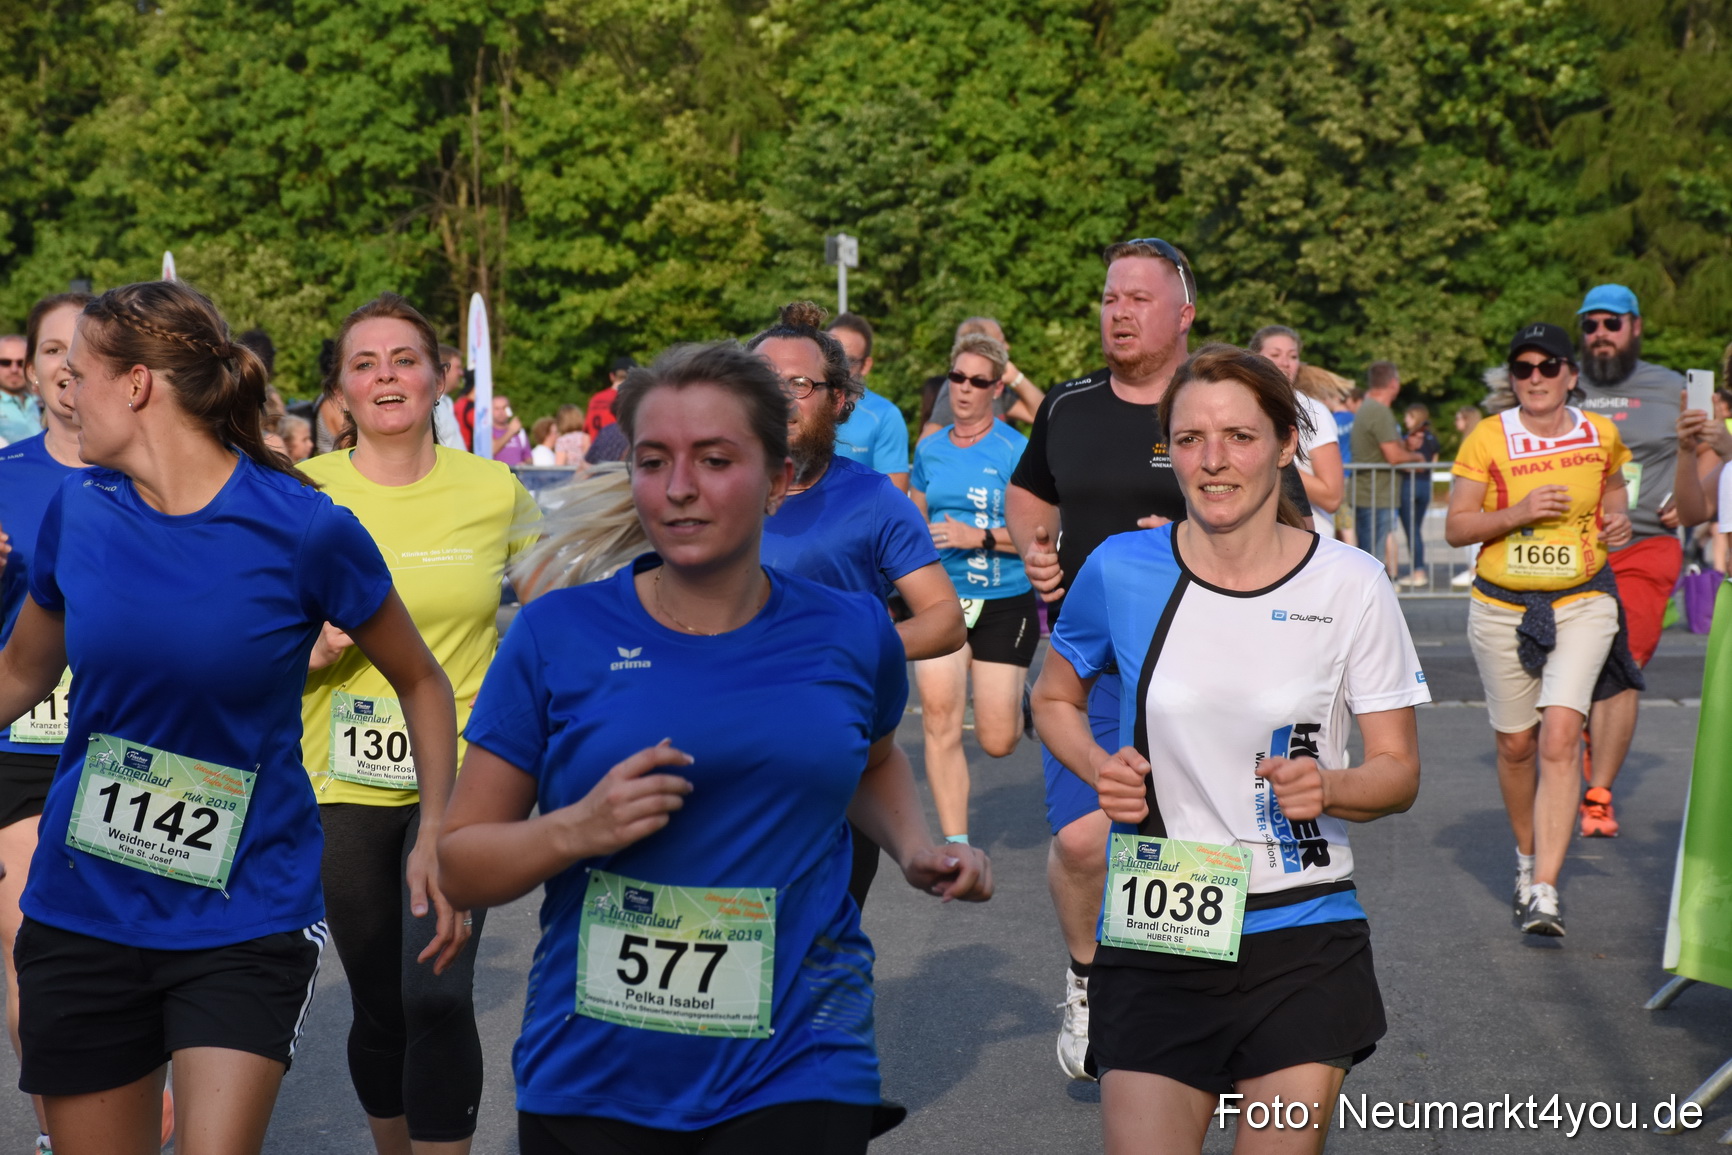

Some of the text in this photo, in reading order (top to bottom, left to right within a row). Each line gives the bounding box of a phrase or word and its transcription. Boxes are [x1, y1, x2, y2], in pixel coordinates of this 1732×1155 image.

[1511, 452, 1605, 477] MAX BÖGL
[94, 482, 117, 492] JAKO
[422, 555, 454, 563] Neumarkt
[1514, 544, 1570, 565] 1666
[1289, 613, 1334, 624] owayo
[610, 660, 652, 671] erima
[346, 710, 392, 724] firmenlauf
[344, 726, 412, 763] 130
[109, 760, 173, 788] firmenlauf
[357, 760, 391, 772] Wagner
[357, 769, 382, 778] Klinikum
[205, 797, 237, 812] 2019
[1254, 793, 1267, 832] WATER
[98, 782, 219, 851] 1142
[108, 827, 157, 851] Weidner
[160, 843, 190, 860] Lena
[118, 843, 135, 855] Kita
[136, 849, 147, 858] St.
[148, 852, 173, 866] Josef
[1126, 856, 1181, 873] firmenlauf
[1211, 875, 1239, 887] 2019
[1122, 876, 1224, 926] 1038
[608, 904, 683, 929] firmenlauf
[727, 929, 762, 941] 2019
[1126, 918, 1210, 937] Brandl Christina
[1147, 932, 1172, 942] HUBER
[616, 934, 728, 993] 577
[625, 988, 715, 1010] Pelka Isabel
